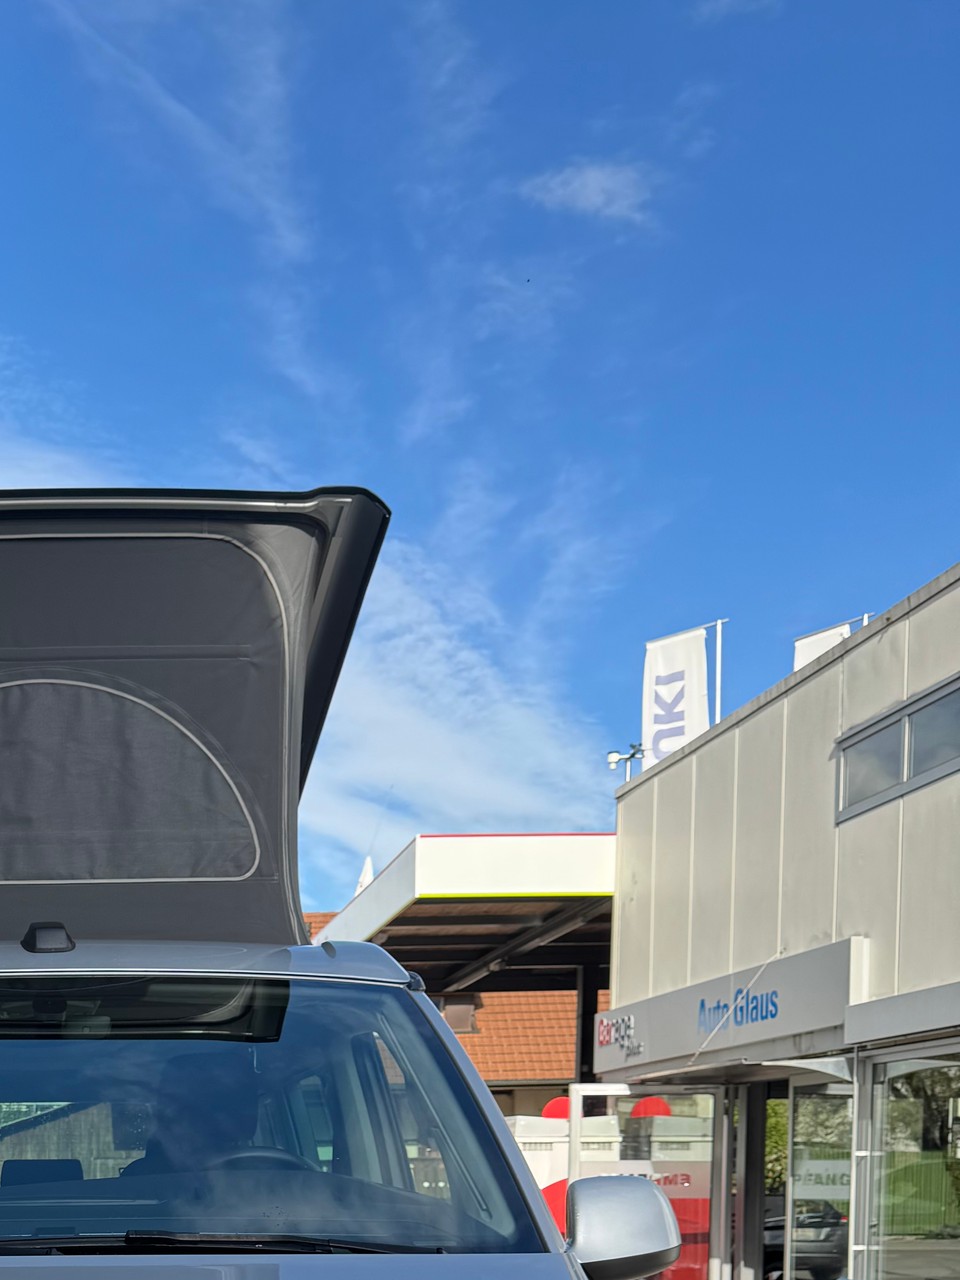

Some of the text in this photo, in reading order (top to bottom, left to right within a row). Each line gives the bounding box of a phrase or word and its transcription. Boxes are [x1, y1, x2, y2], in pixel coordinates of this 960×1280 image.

[697, 987, 780, 1036] Auto Glaus
[597, 1016, 636, 1051] Garage
